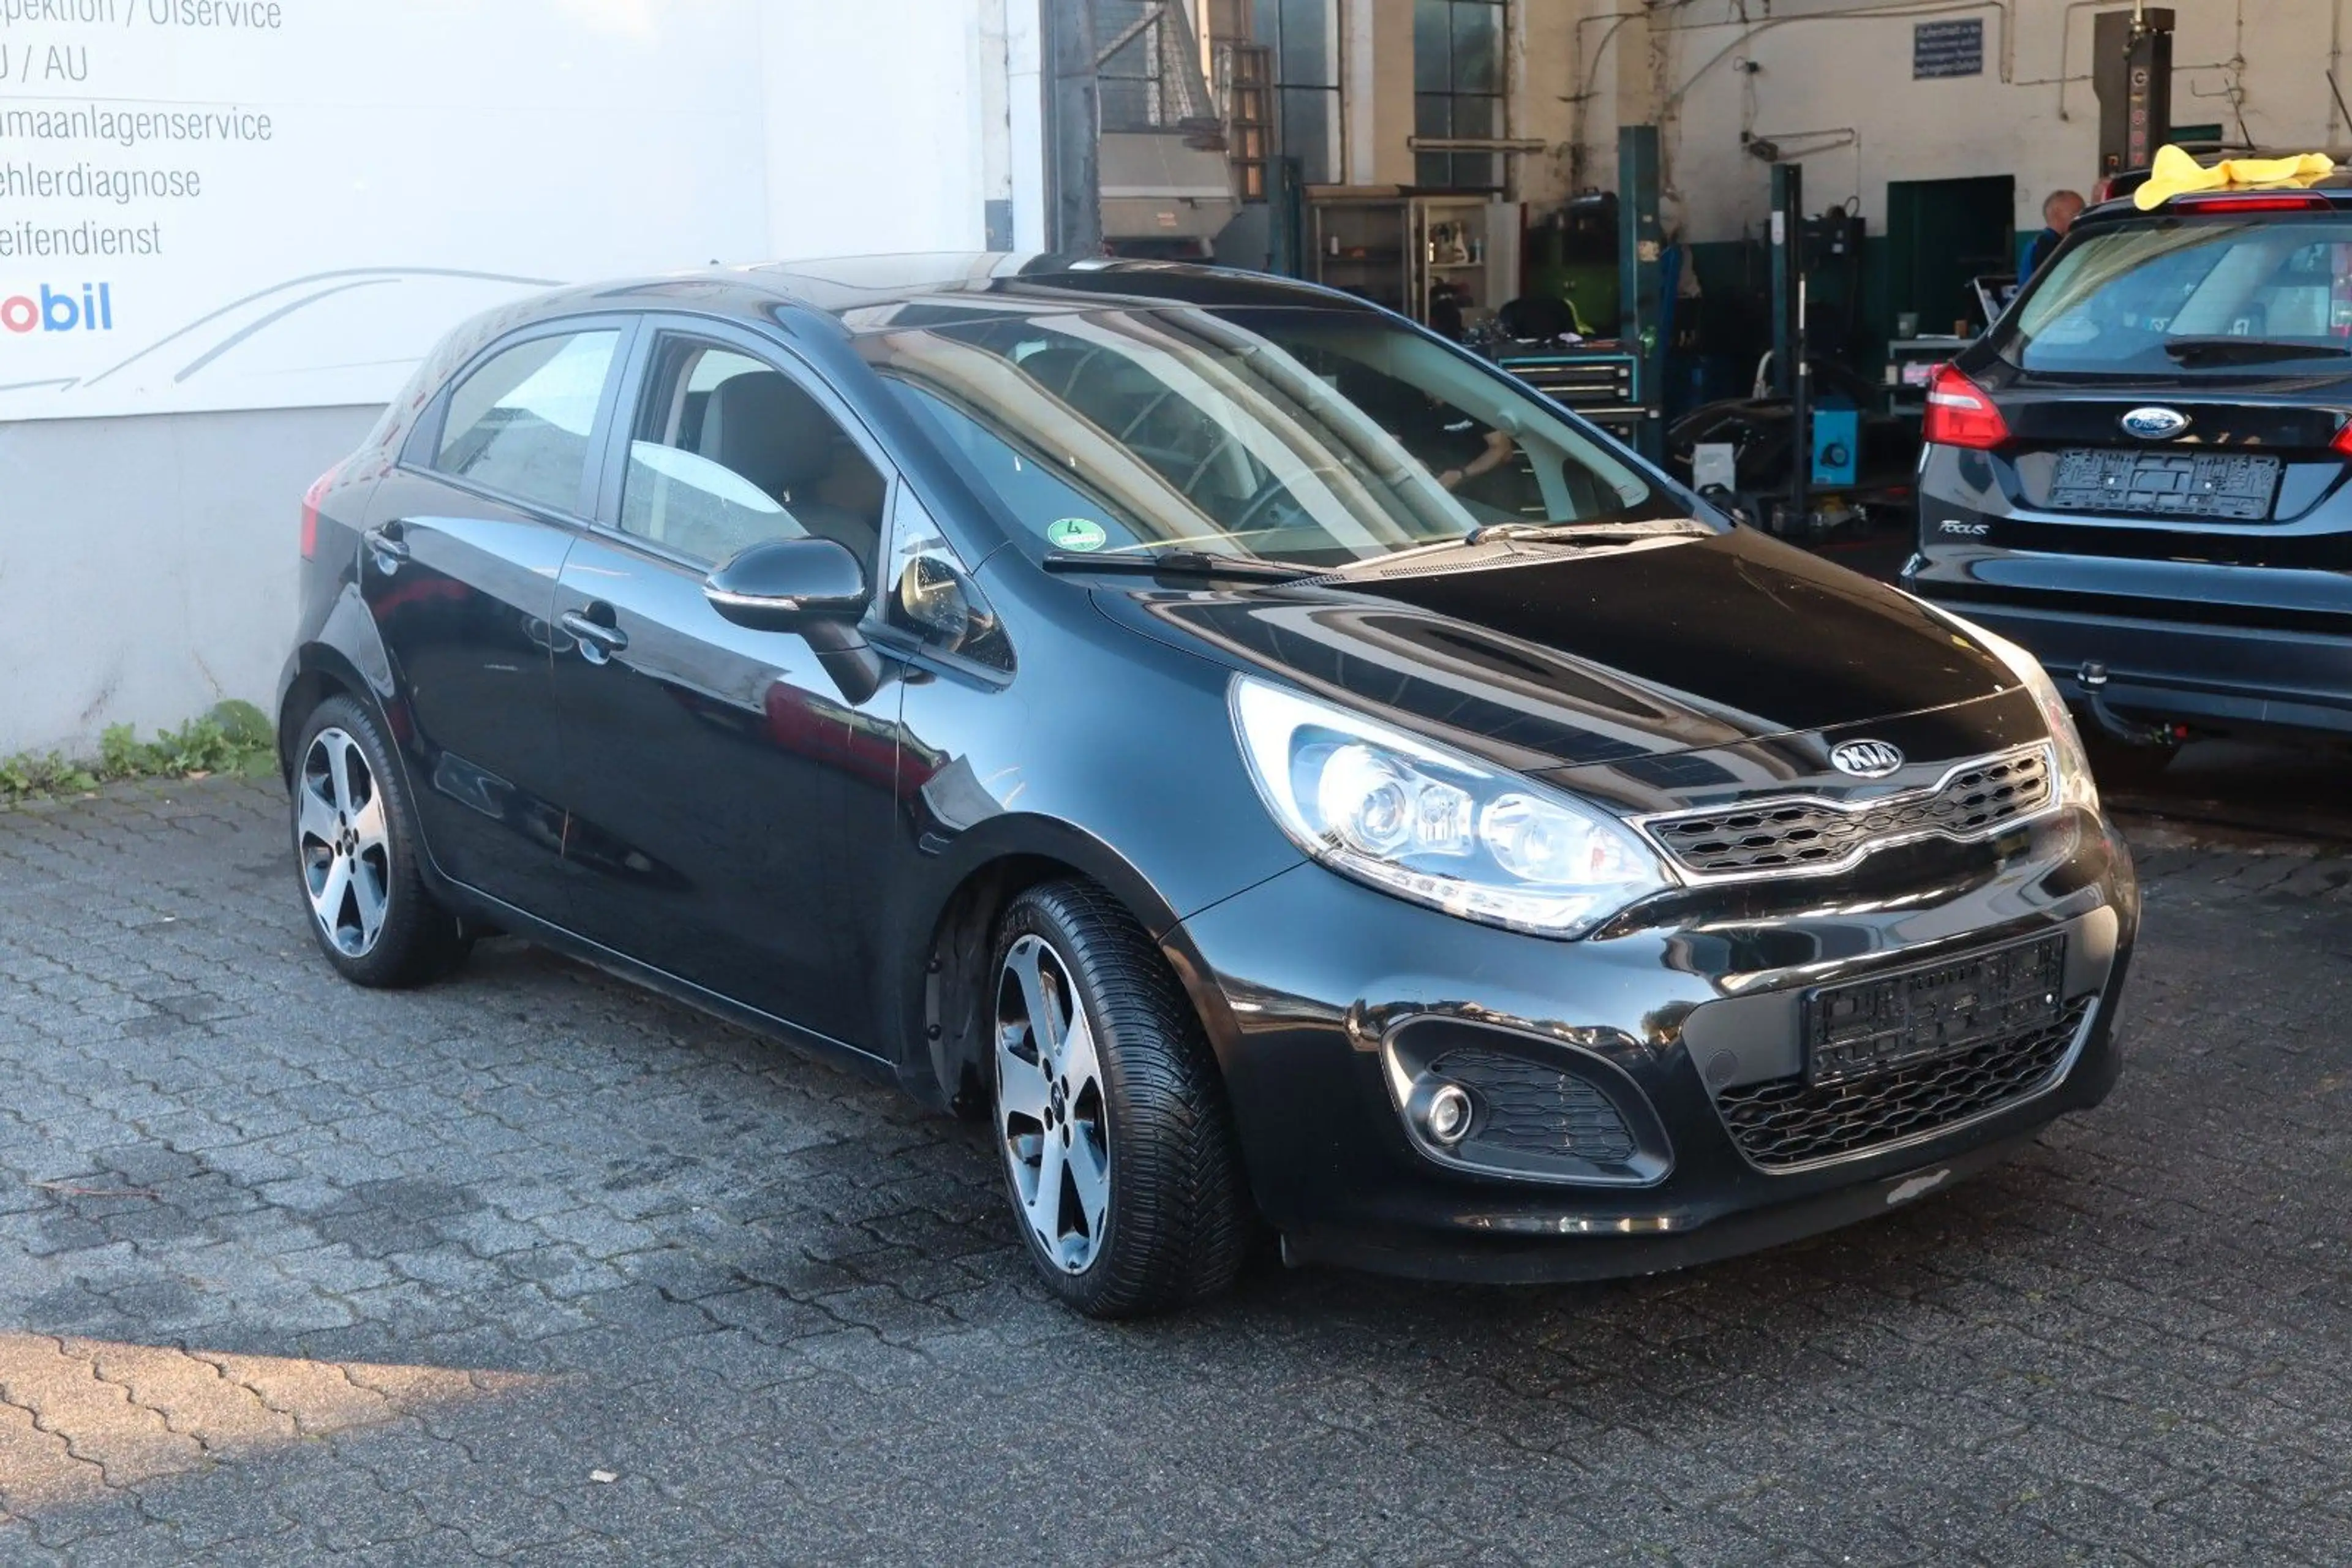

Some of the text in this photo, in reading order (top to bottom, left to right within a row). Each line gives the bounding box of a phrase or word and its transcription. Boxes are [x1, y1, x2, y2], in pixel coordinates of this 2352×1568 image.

[0, 0, 115, 27] pektion
[45, 45, 87, 81] AU
[1, 282, 112, 333] obil
[1067, 521, 1082, 534] 4
[1840, 743, 1898, 769] KIA
